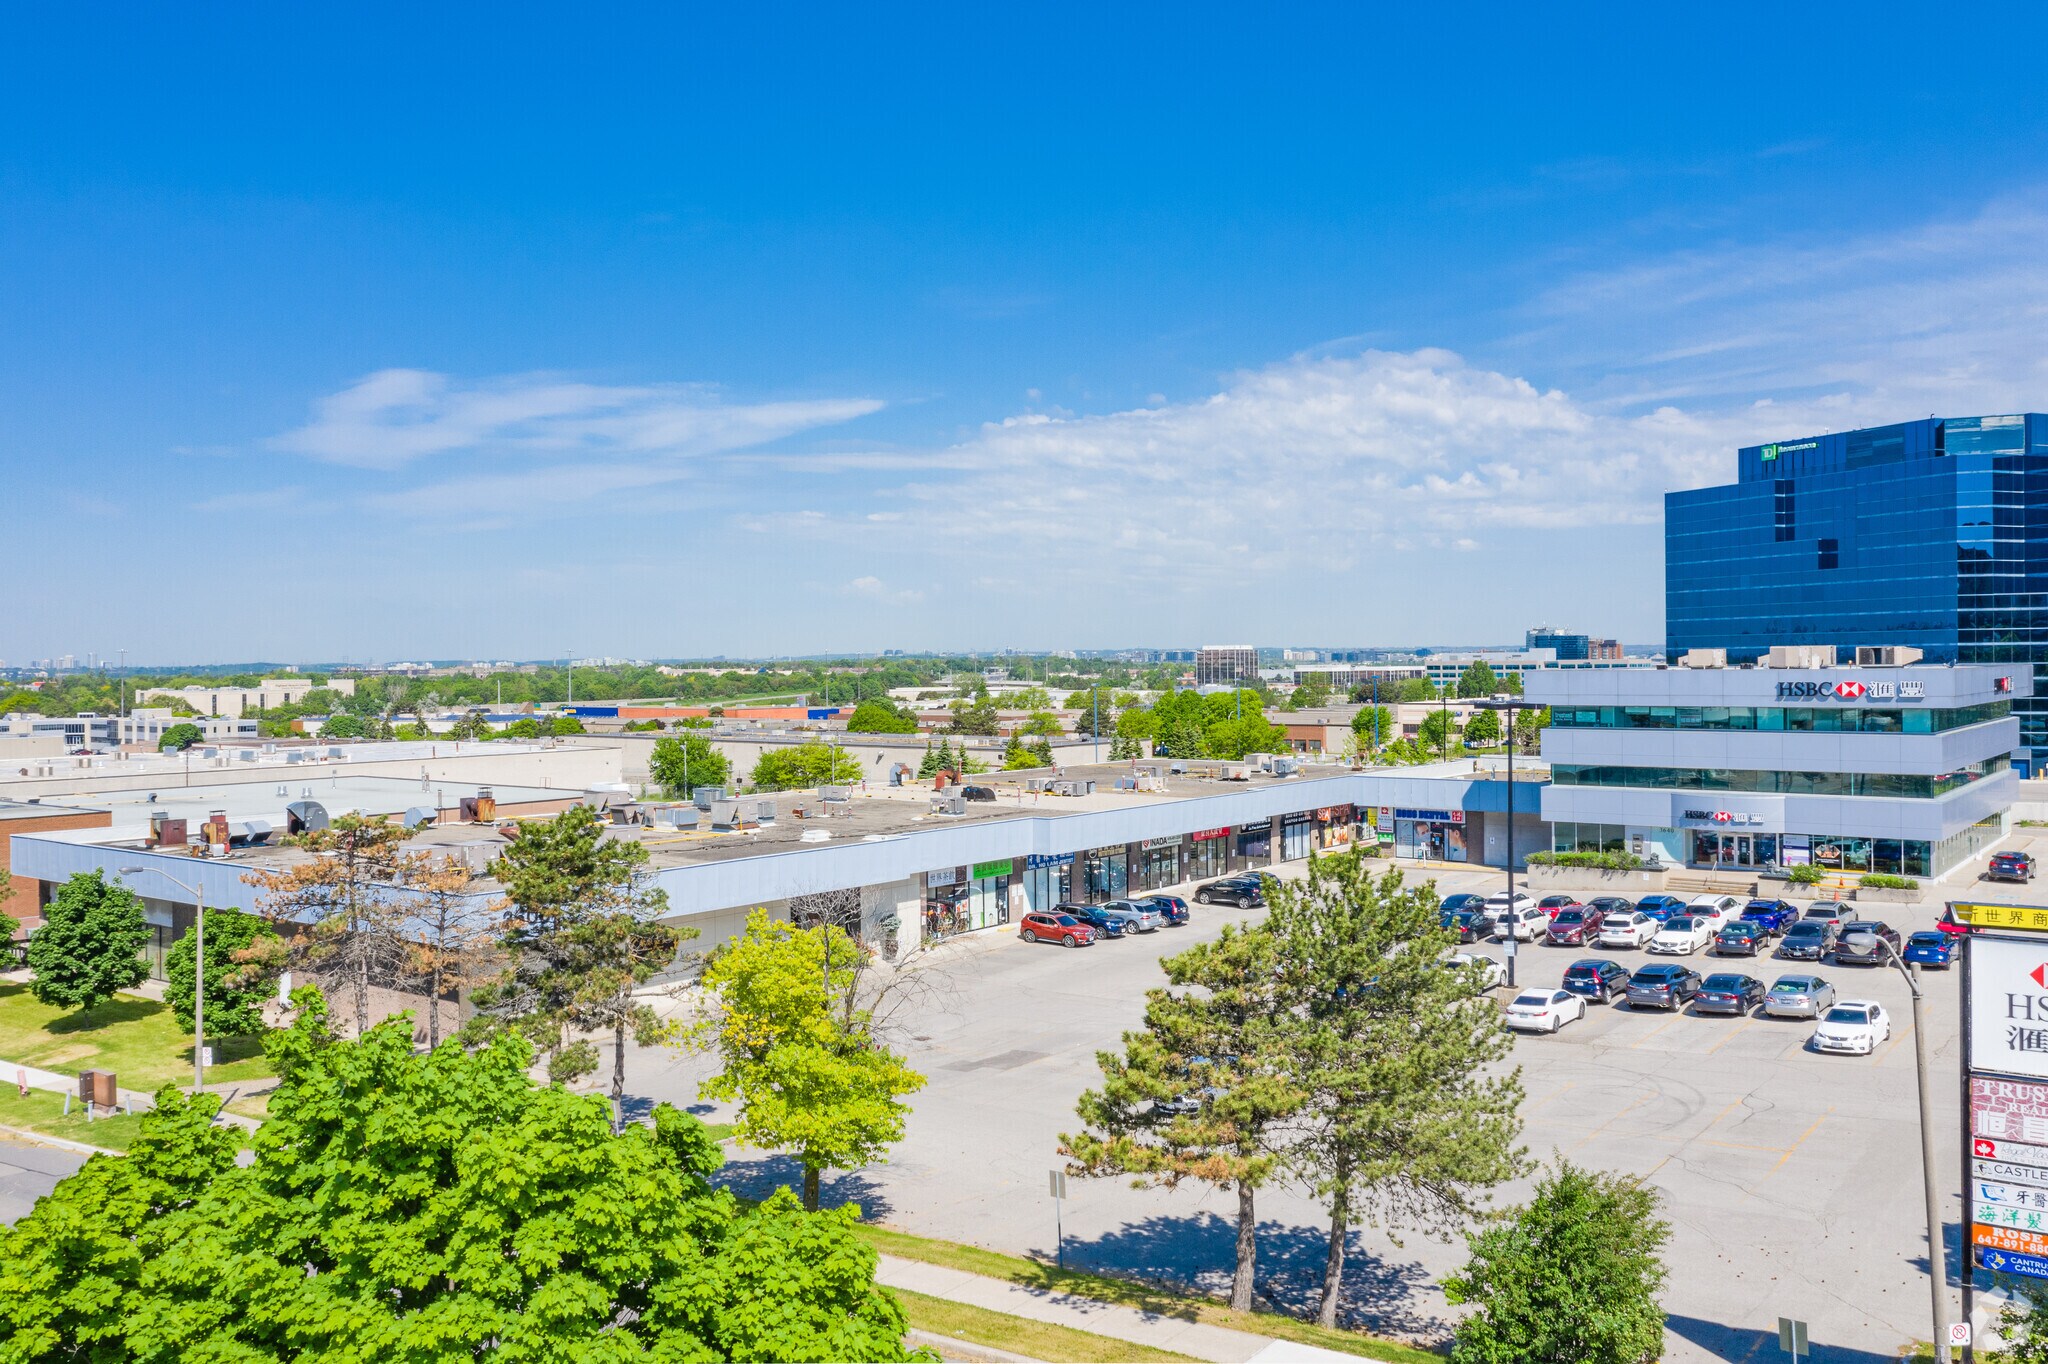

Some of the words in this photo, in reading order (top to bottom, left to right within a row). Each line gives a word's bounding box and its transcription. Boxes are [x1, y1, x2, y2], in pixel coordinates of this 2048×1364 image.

[1777, 681, 1833, 697] HSBC
[1684, 810, 1714, 820] HSBC
[1994, 1165, 2048, 1180] CASTLE
[1993, 1227, 2043, 1244] ROSE
